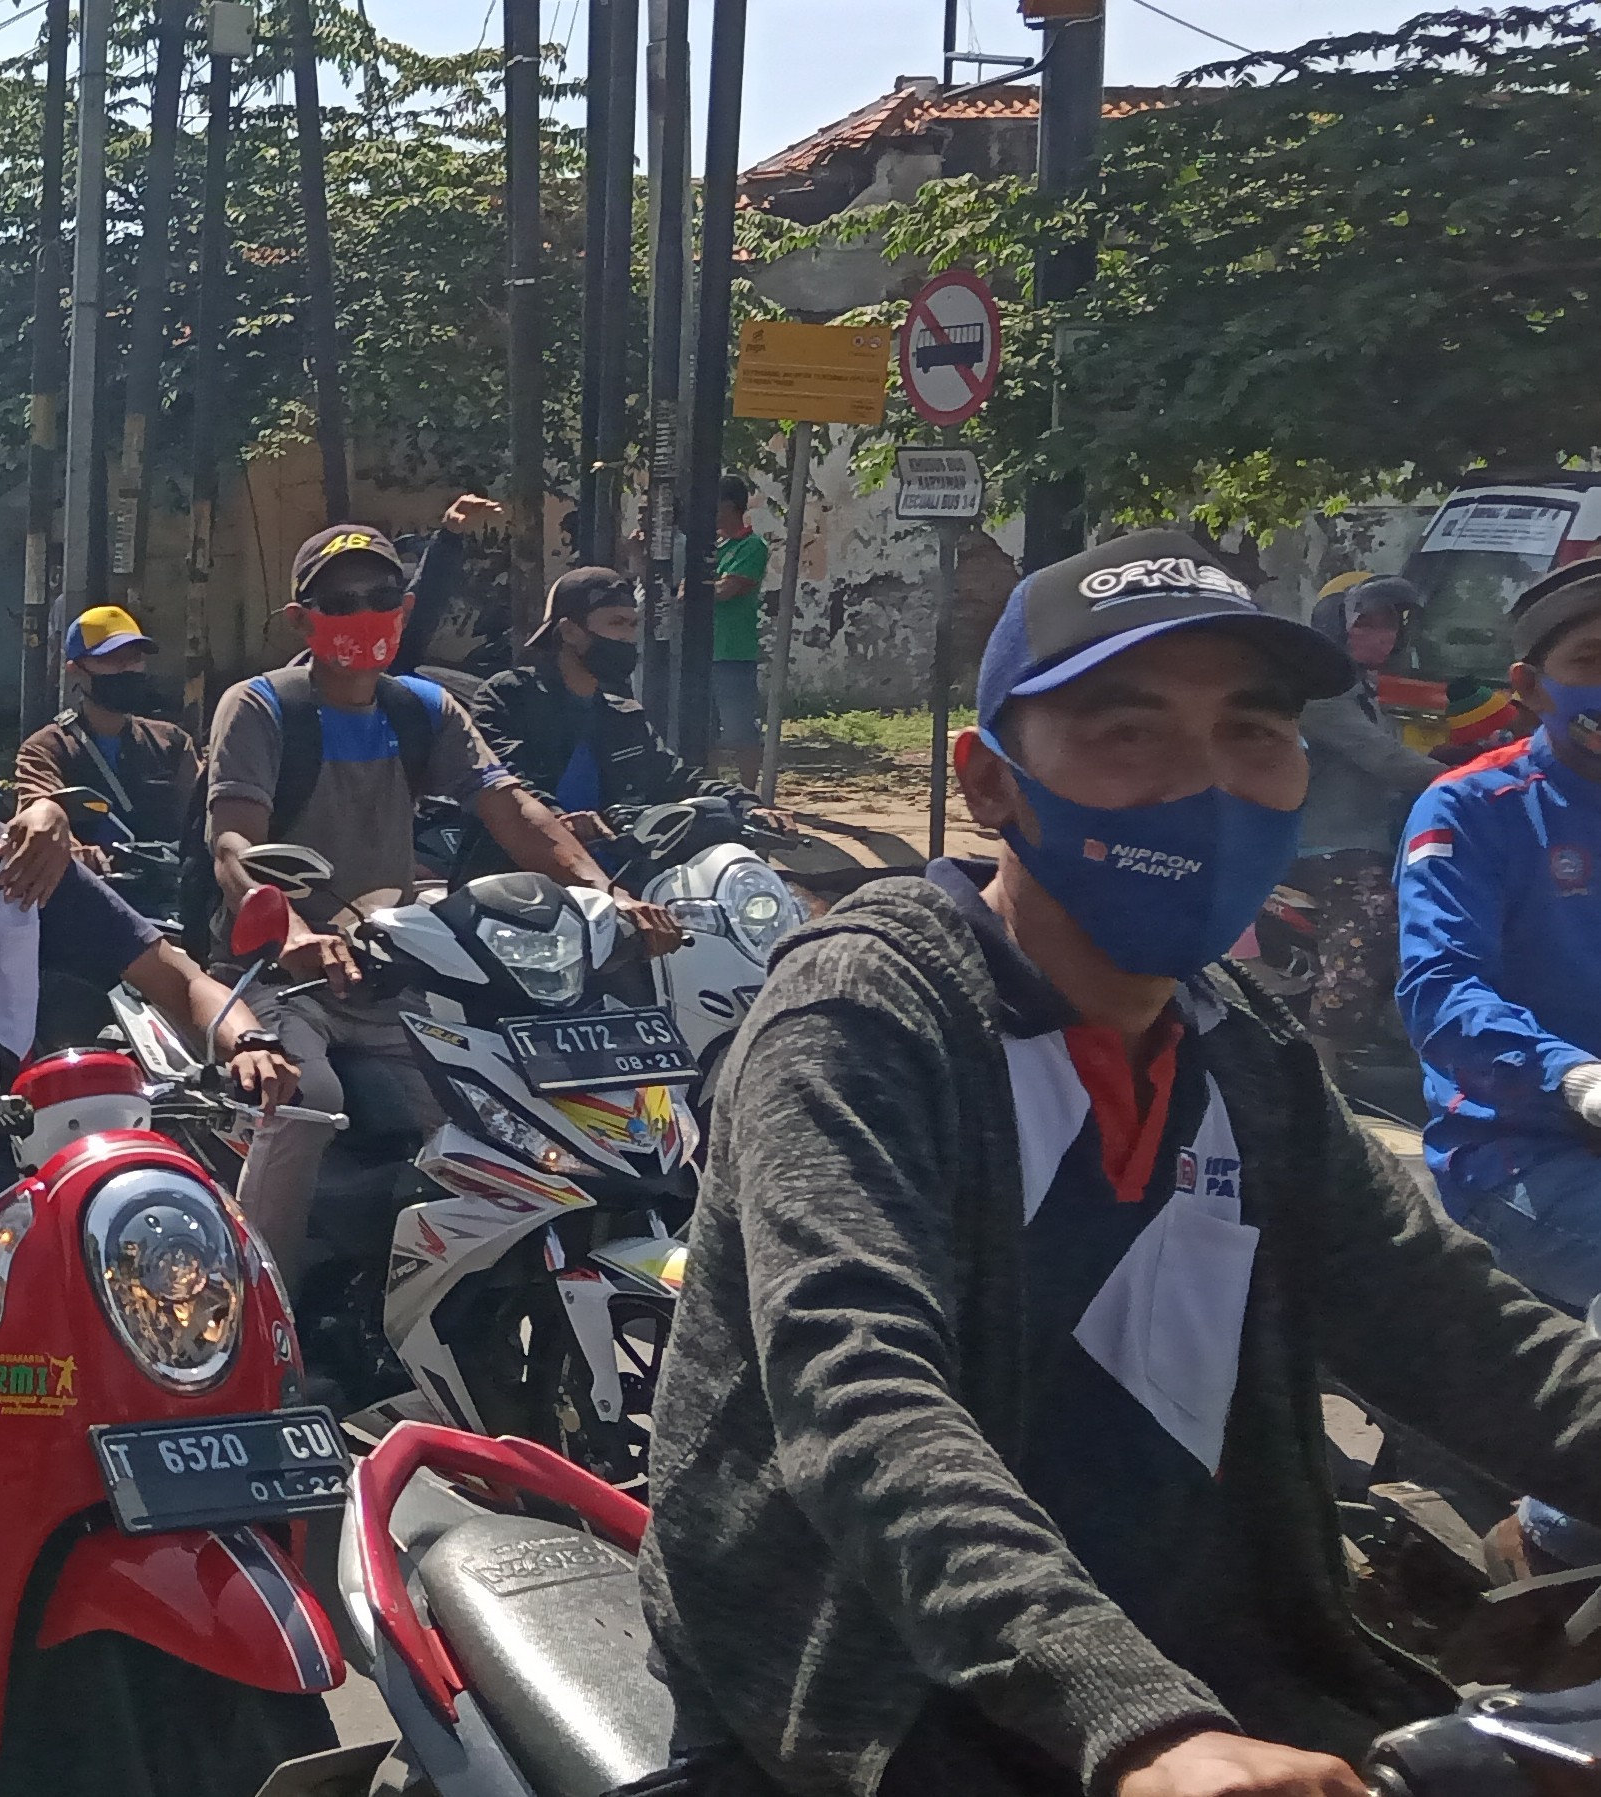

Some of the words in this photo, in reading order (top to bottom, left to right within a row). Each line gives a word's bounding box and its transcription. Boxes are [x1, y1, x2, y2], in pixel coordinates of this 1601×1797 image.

[318, 533, 372, 557] 46
[1111, 844, 1203, 873] NIPPON
[1115, 857, 1189, 881] PAINT
[516, 1031, 537, 1056] T
[555, 1025, 617, 1052] 4172
[634, 1019, 672, 1045] CS
[109, 1444, 134, 1478] T
[158, 1433, 249, 1474] 6520
[282, 1423, 333, 1460] CU
